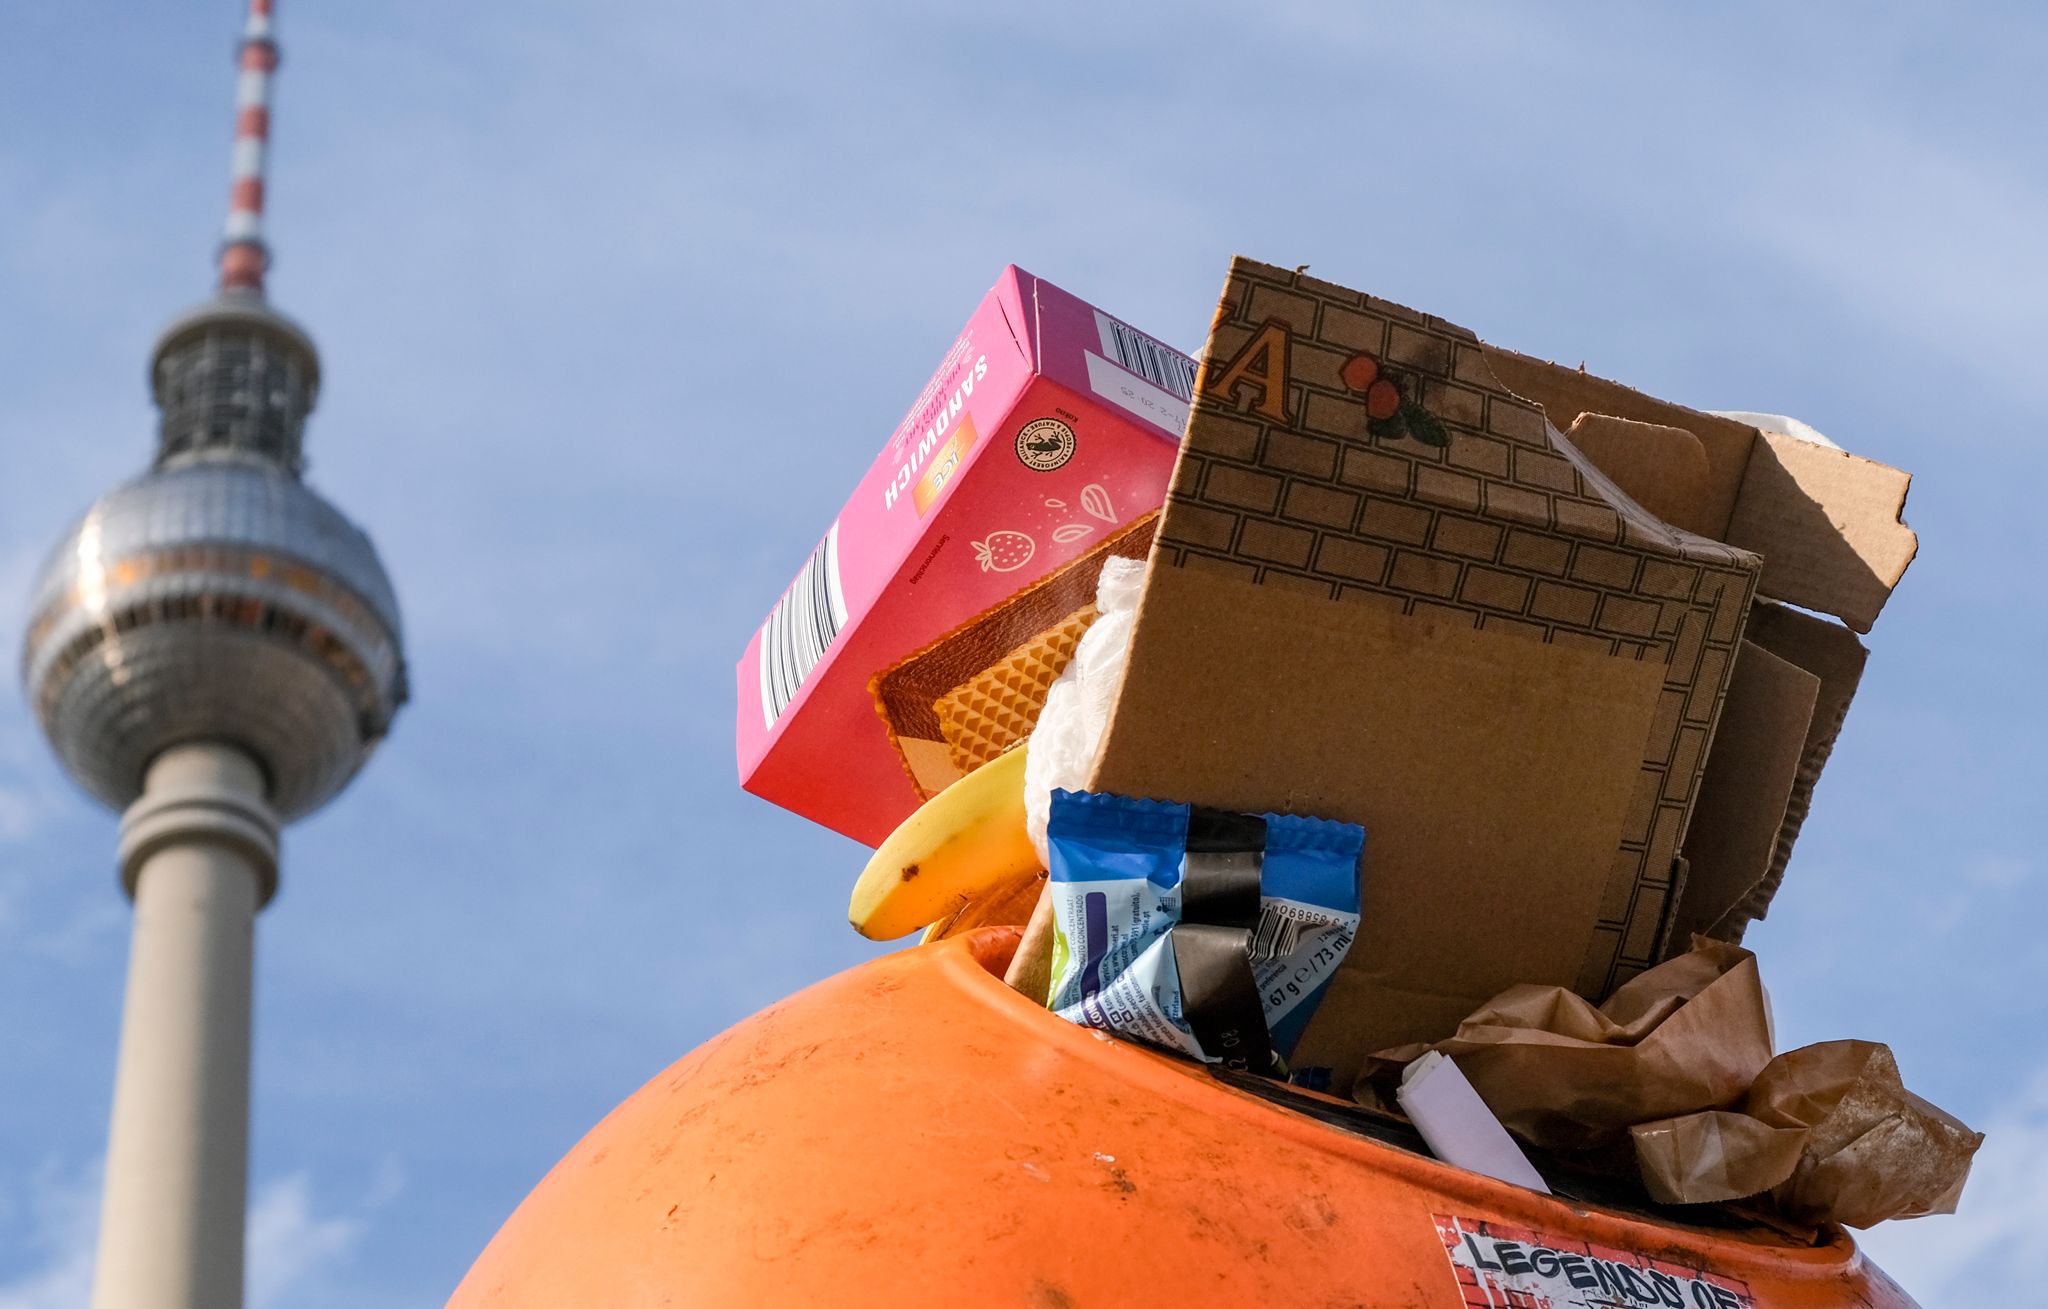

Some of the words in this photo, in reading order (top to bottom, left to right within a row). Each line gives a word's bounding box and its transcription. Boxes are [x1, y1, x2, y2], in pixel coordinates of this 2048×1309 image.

[1030, 421, 1055, 429] NATURE
[1055, 407, 1078, 423] Kakao
[883, 355, 988, 510] SANDWICH
[1019, 431, 1029, 460] ALLIANCE
[1062, 428, 1072, 449] PEOPLE
[933, 452, 959, 489] ICE
[1029, 453, 1068, 468] RAINFOREST
[1076, 895, 1085, 943] CONCENTRADO
[1270, 988, 1288, 1007] 67
[1287, 981, 1300, 995] g
[1315, 947, 1334, 965] 73
[1332, 935, 1351, 951] ml
[1463, 1232, 1685, 1309] LEGENDS
